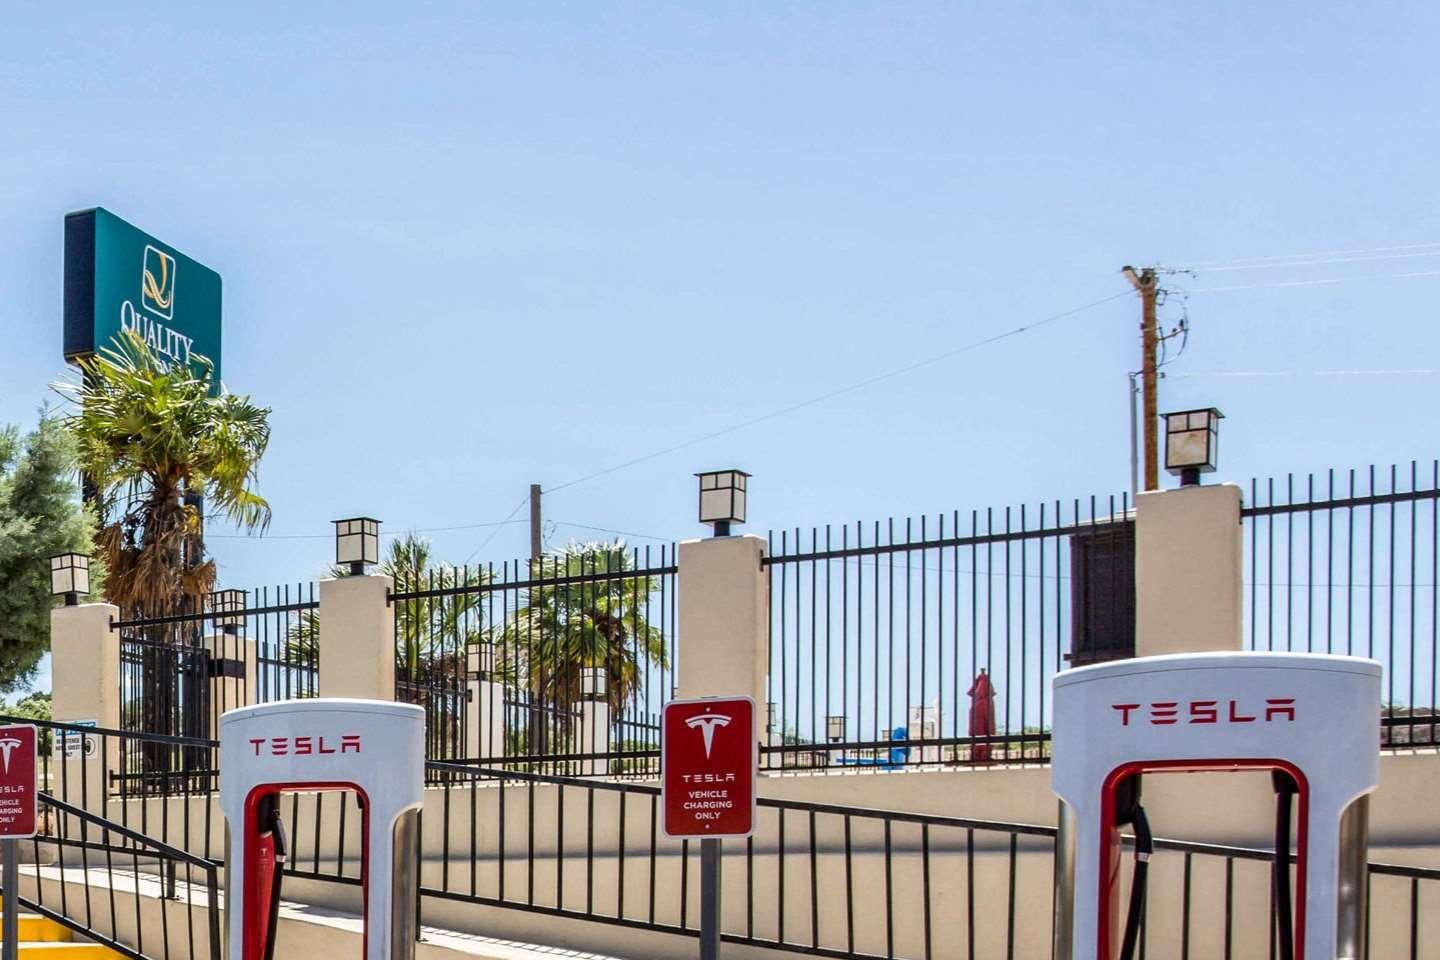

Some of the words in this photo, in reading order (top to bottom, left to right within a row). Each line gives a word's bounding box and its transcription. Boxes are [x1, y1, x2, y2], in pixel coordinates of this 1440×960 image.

[121, 300, 194, 366] QUALITY
[1111, 699, 1296, 726] TESLA
[249, 735, 361, 756] TESLA
[682, 773, 736, 783] TESLA
[688, 790, 728, 799] VEHICLE
[683, 800, 733, 810] CHARGING
[695, 811, 720, 820] ONLY
